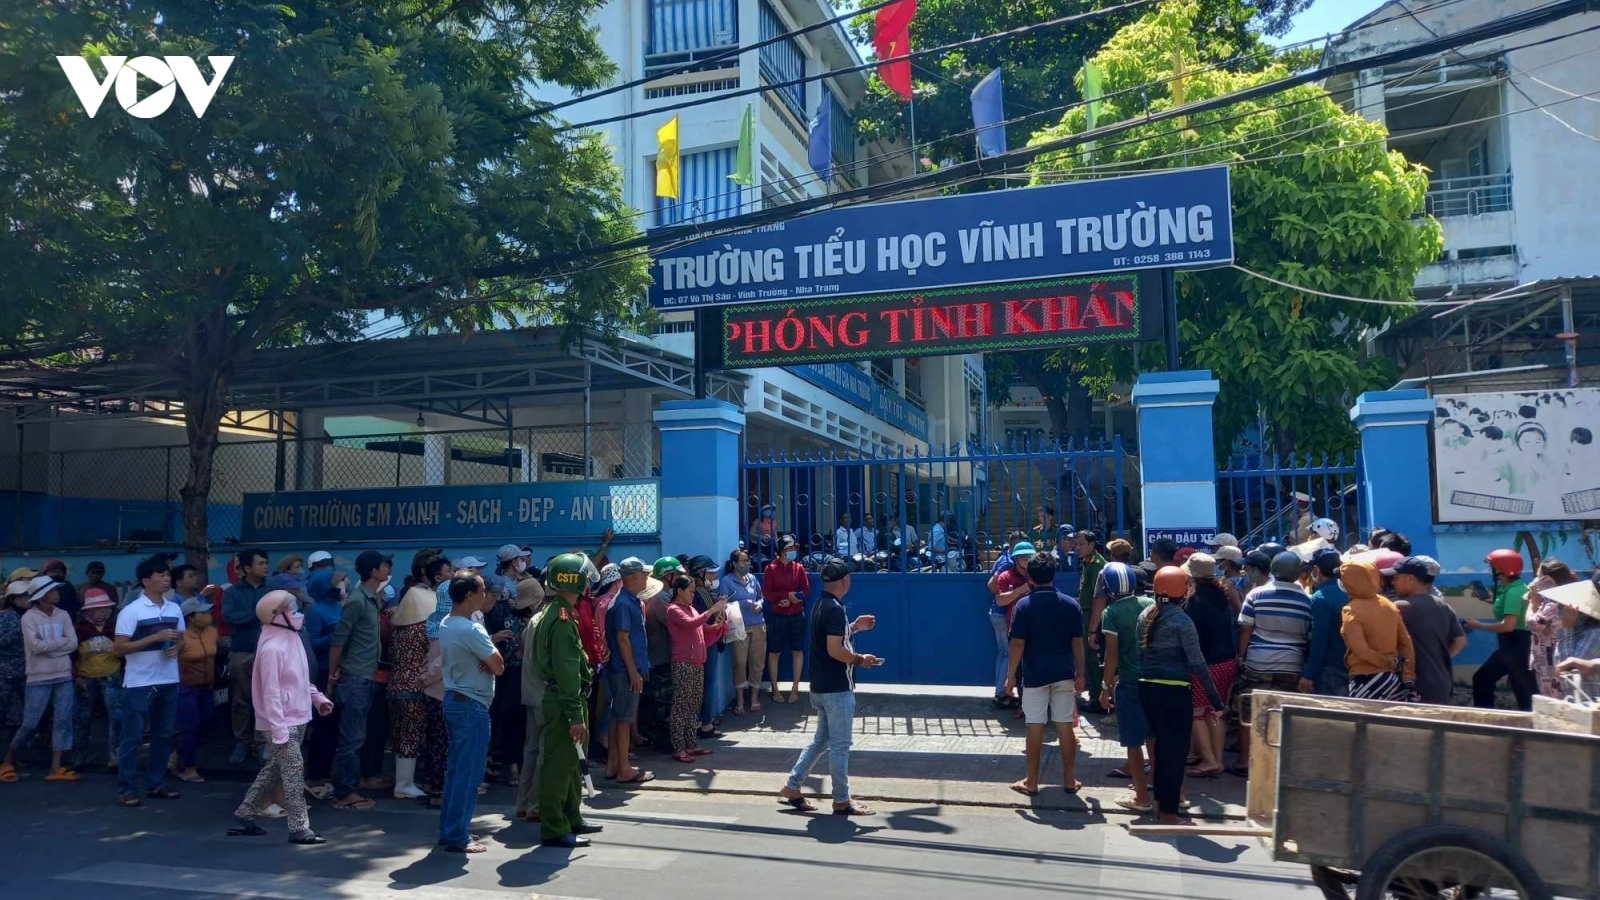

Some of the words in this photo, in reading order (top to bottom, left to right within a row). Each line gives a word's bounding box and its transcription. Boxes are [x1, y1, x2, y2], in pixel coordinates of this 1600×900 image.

[658, 244, 785, 291] TRƯỜNG
[794, 226, 866, 279] TIỂU
[877, 231, 947, 276] HỌC
[958, 220, 1044, 264] VĨNH
[1056, 201, 1214, 255] TRƯỜNG
[1133, 254, 1160, 265] 0258
[1164, 251, 1184, 262] 388
[678, 295, 688, 304] 07
[702, 293, 714, 303] Thị
[795, 286, 813, 295] Nha
[815, 284, 840, 293] Trang
[880, 297, 992, 344] TỈNH
[299, 498, 362, 528] TRƯỜNG
[365, 502, 392, 527] EM
[395, 501, 440, 526] XANH
[456, 499, 501, 529] SẠCH
[518, 497, 555, 528] ĐẸP
[570, 496, 594, 521] AN
[1175, 531, 1198, 545] ĐẬU
[1199, 533, 1214, 544] XE
[556, 572, 580, 584] CSTT
